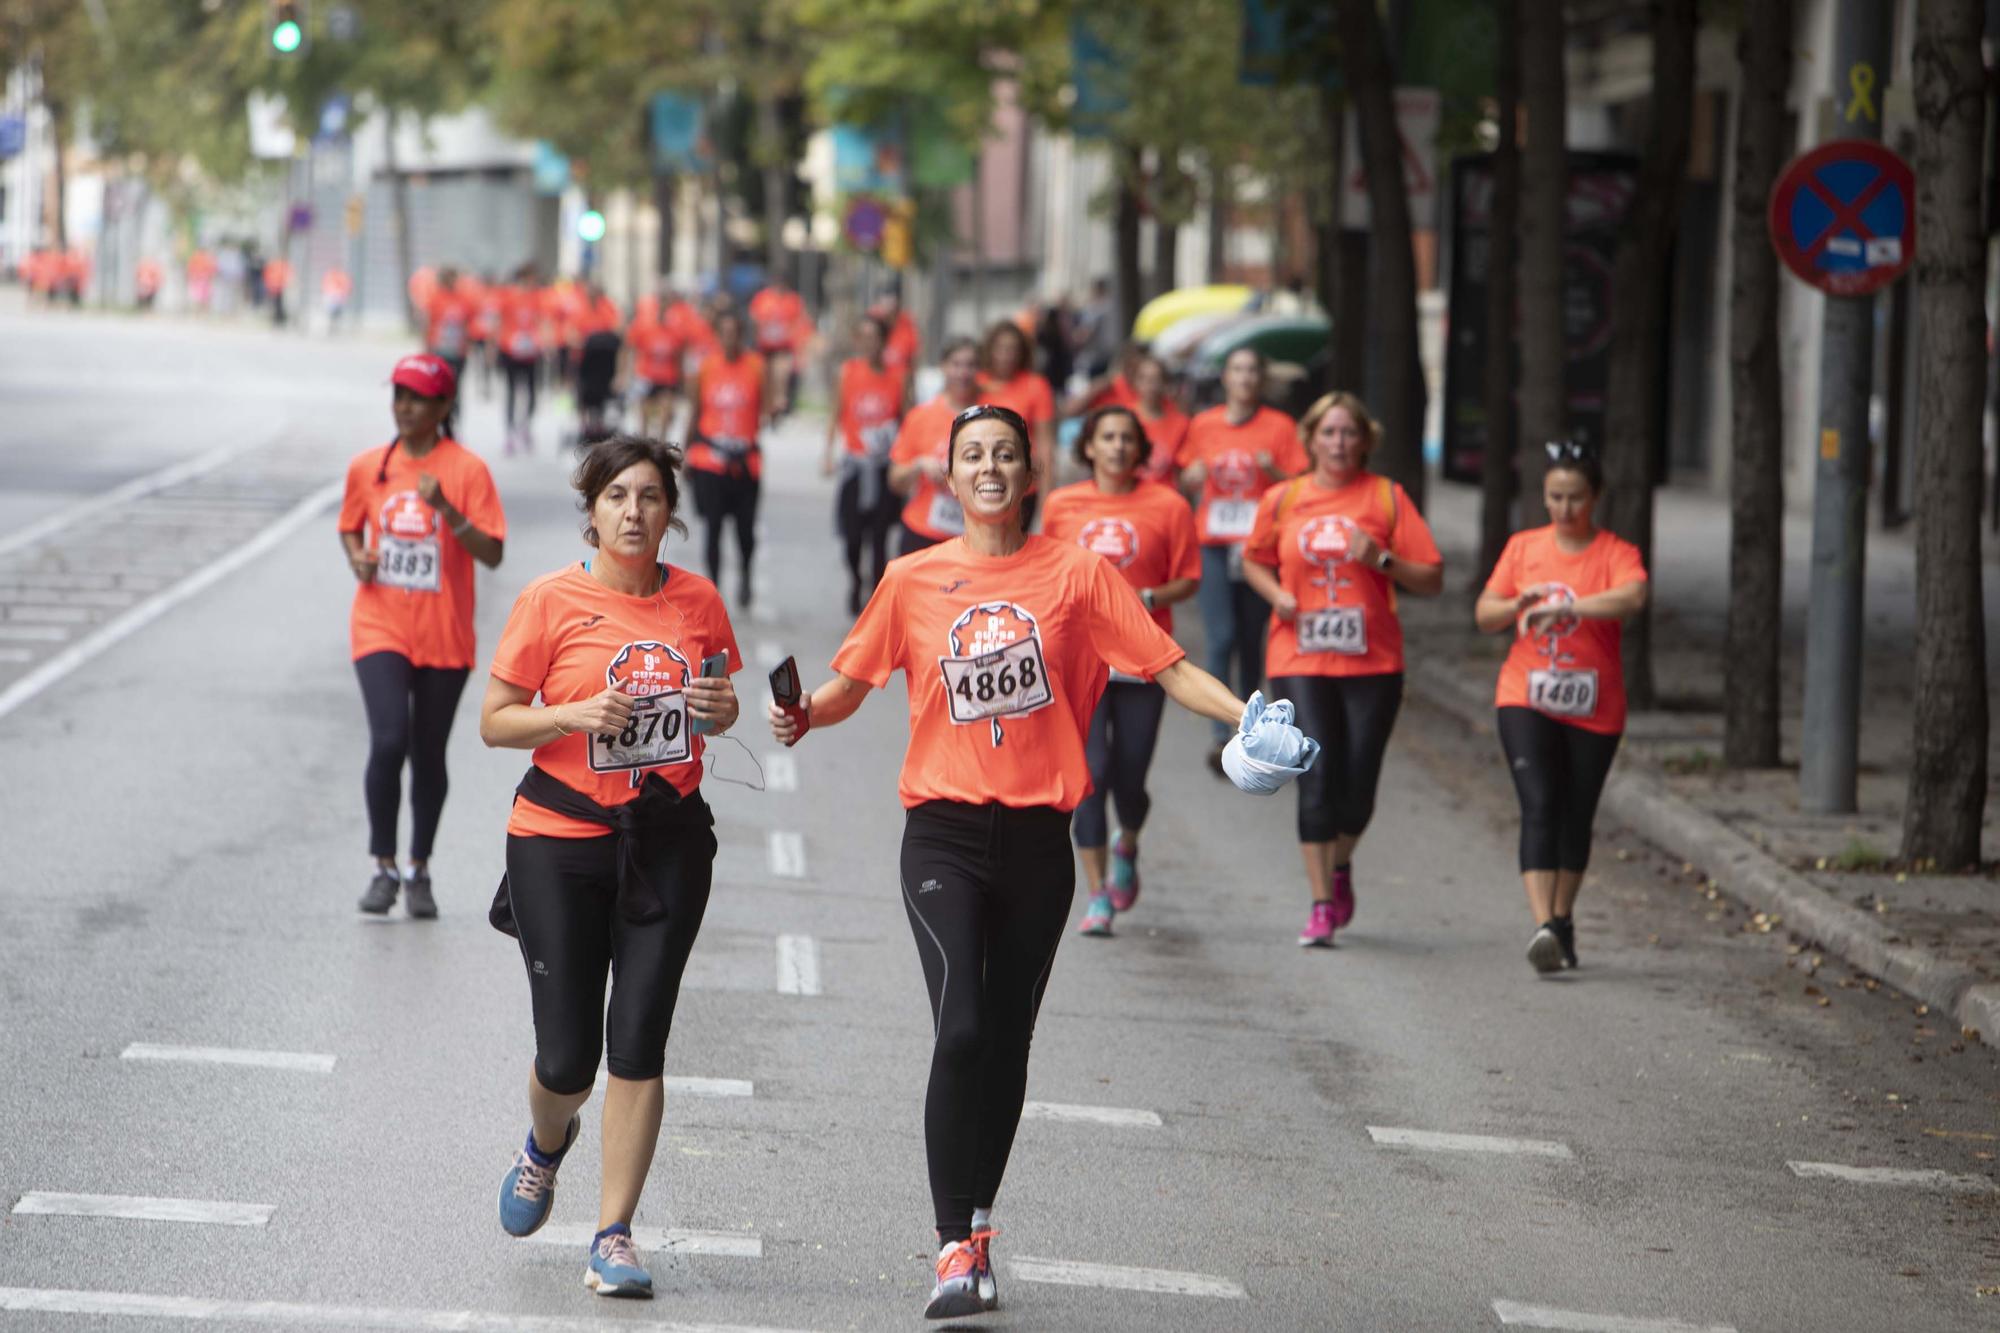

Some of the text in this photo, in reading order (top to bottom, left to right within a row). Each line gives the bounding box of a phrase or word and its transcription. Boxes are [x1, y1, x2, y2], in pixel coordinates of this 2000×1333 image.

[632, 670, 670, 680] cursa
[956, 656, 1037, 702] 4868
[1536, 682, 1590, 706] 1480
